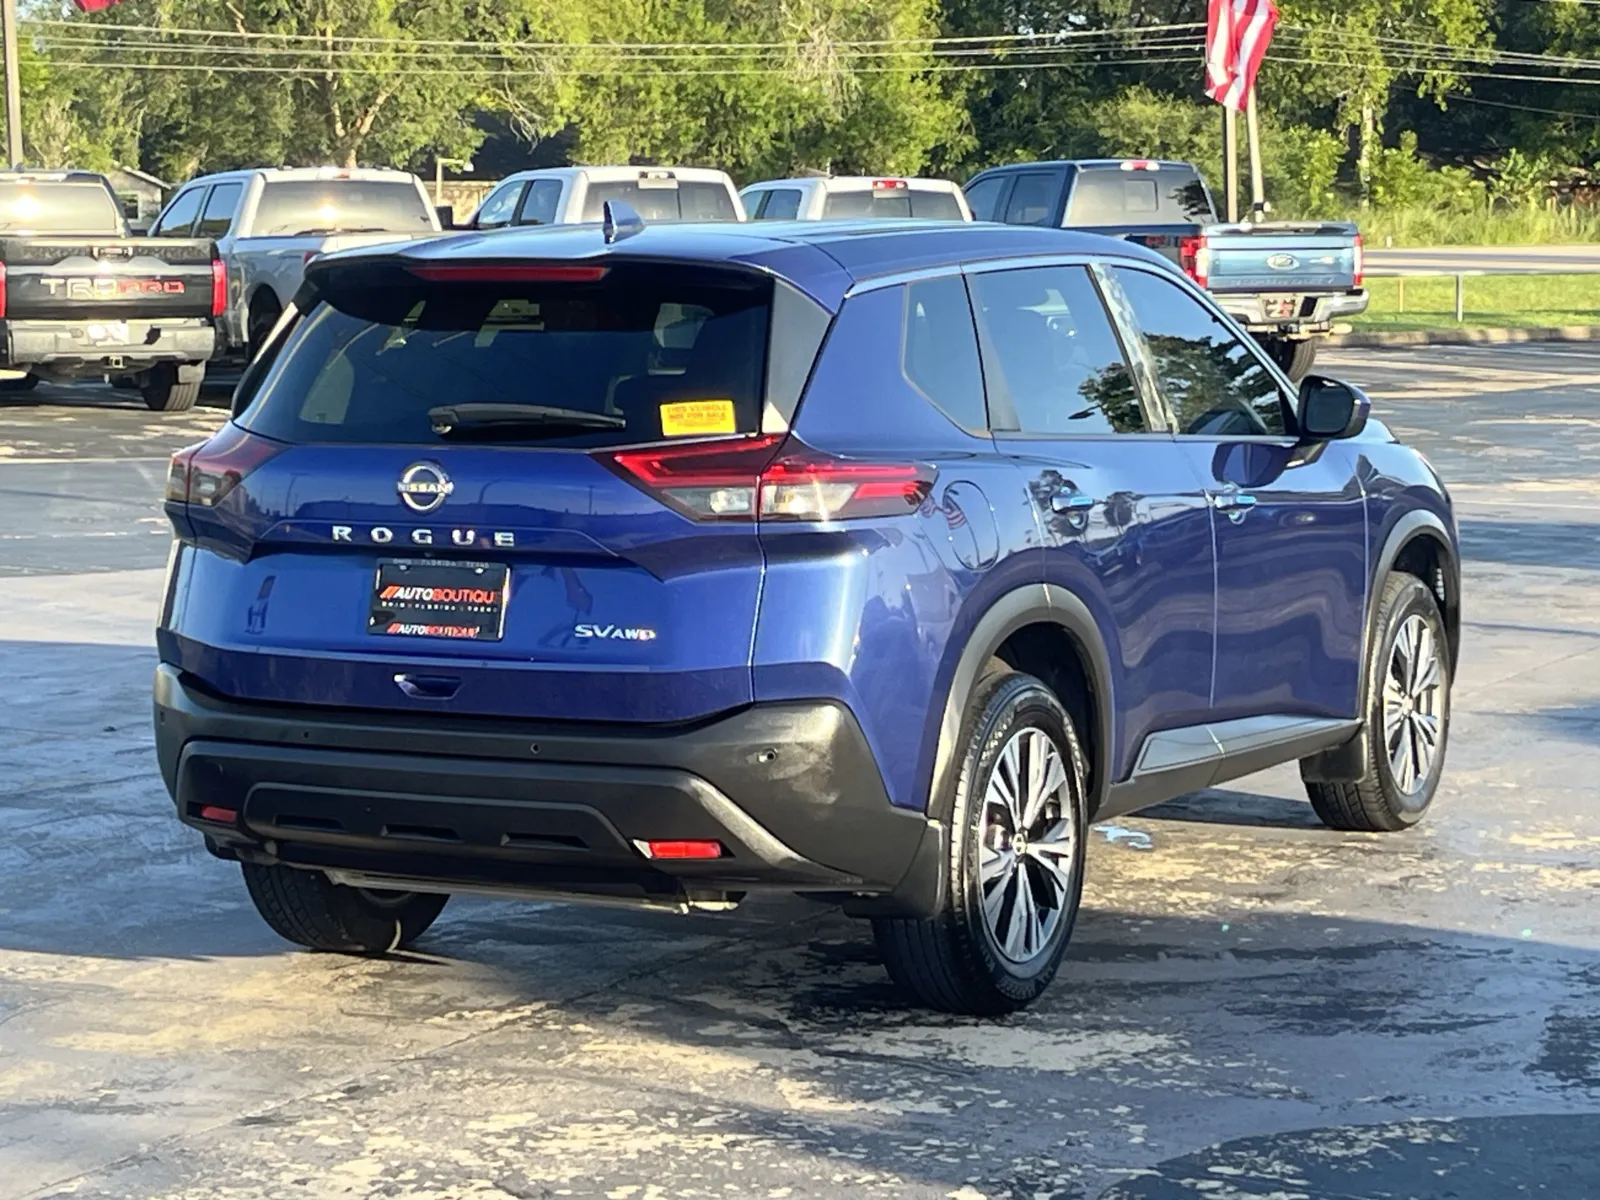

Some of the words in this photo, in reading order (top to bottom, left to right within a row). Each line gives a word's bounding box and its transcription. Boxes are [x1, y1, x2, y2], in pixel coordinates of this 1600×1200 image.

[397, 481, 452, 494] NISSAN
[332, 525, 515, 547] ROGUE
[574, 624, 615, 638] SV
